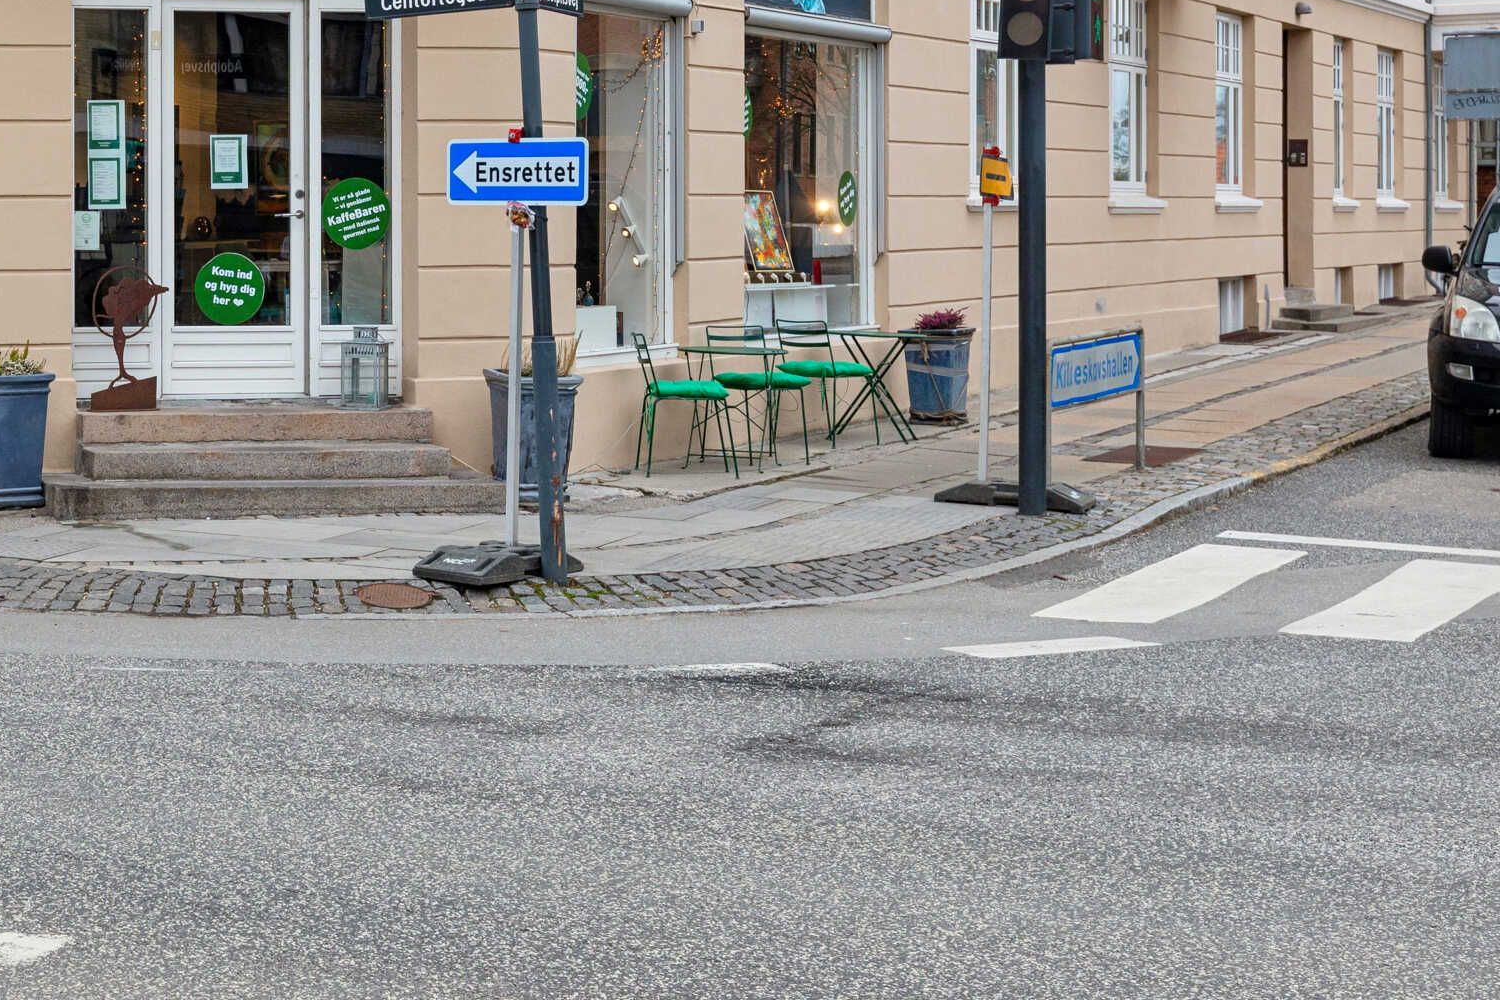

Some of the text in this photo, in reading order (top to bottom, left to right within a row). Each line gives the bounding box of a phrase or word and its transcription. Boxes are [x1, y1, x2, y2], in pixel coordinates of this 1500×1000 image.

[476, 161, 576, 183] Ensrettet
[327, 203, 386, 227] KaffeBaren
[211, 265, 253, 280] Kom ind
[204, 280, 256, 297] og hyg dig
[212, 294, 231, 306] her
